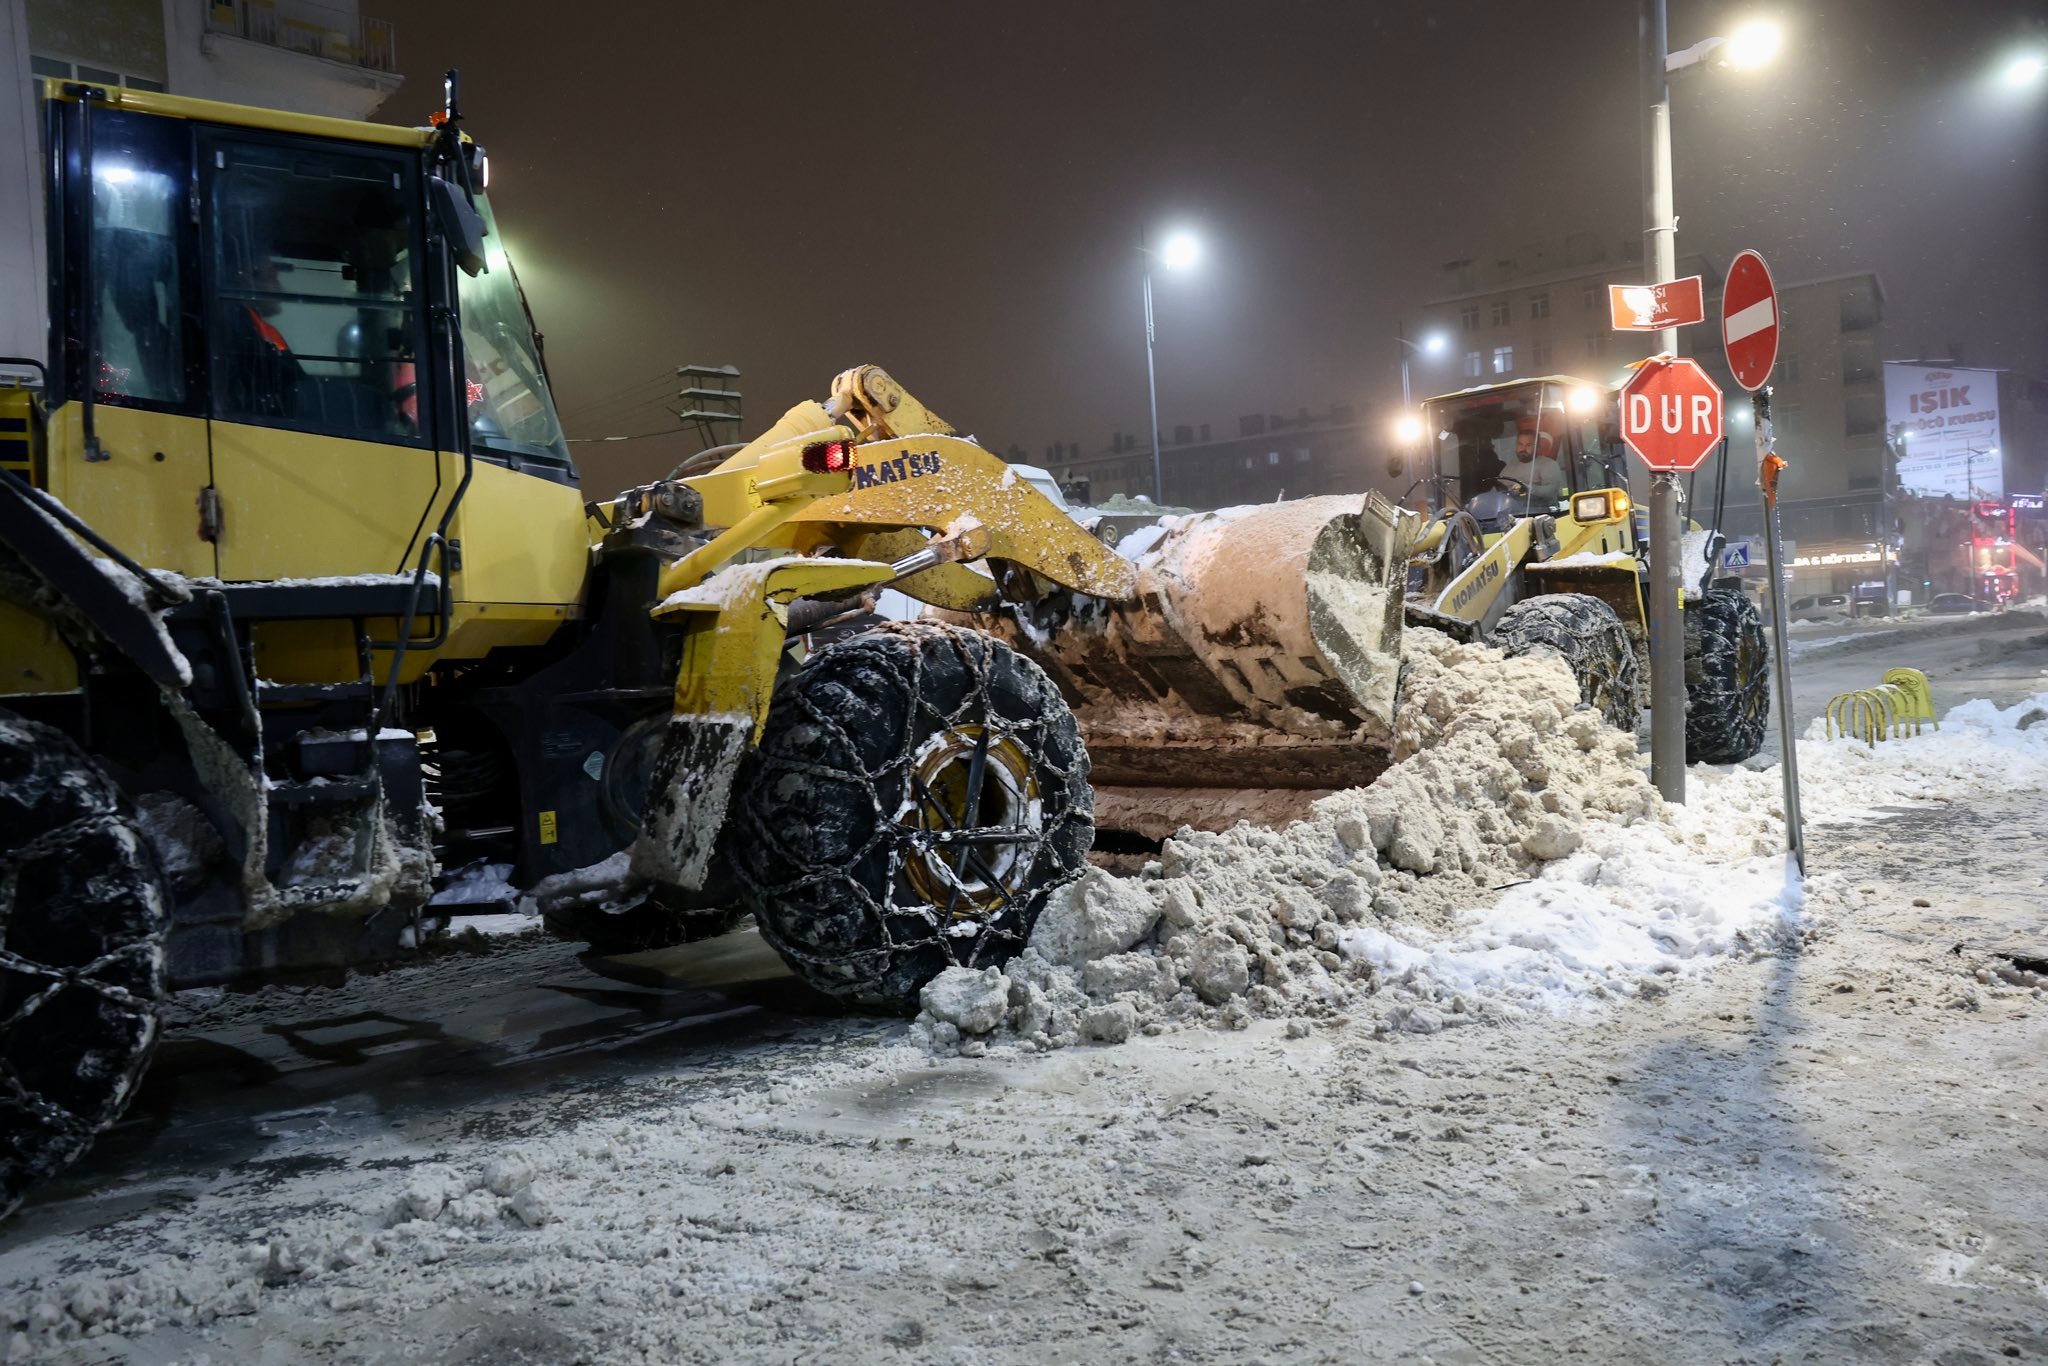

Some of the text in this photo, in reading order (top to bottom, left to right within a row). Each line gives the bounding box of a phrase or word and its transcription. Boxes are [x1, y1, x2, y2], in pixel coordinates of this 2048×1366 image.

[1630, 394, 1713, 435] DUR
[1910, 385, 1971, 414] IŞIK
[1452, 560, 1499, 612] KOMATSU
